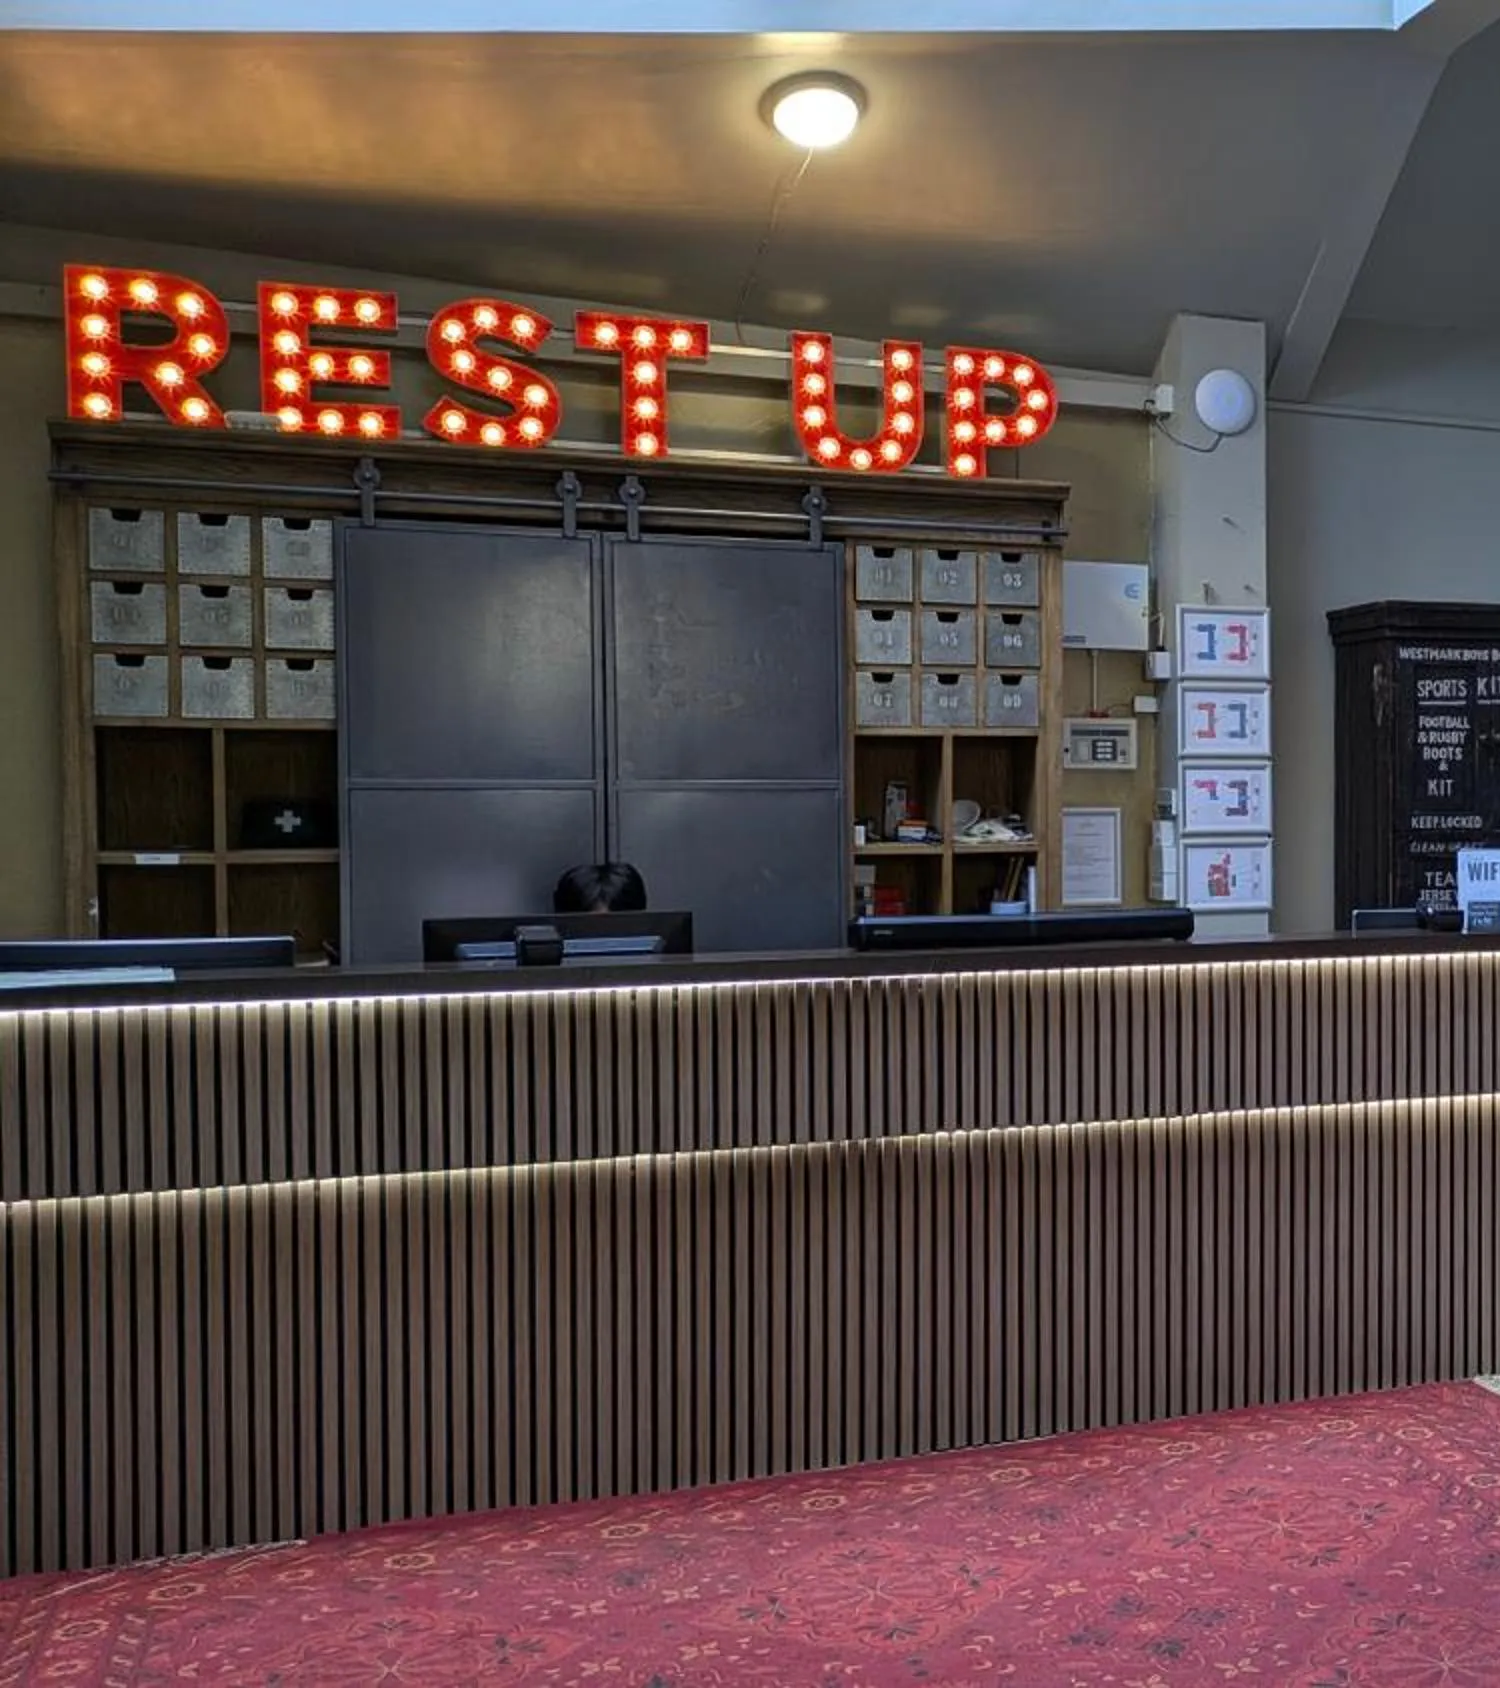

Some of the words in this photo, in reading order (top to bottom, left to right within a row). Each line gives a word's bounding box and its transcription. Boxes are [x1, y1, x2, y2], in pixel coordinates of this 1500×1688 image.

[64, 264, 710, 458] REST
[790, 330, 1057, 478] UP
[1002, 572, 1022, 588] 03
[1416, 679, 1467, 698] SPORTS
[1418, 715, 1471, 729] FOOTBALL
[1423, 747, 1463, 761] BOOTS
[1427, 779, 1454, 797] KIT
